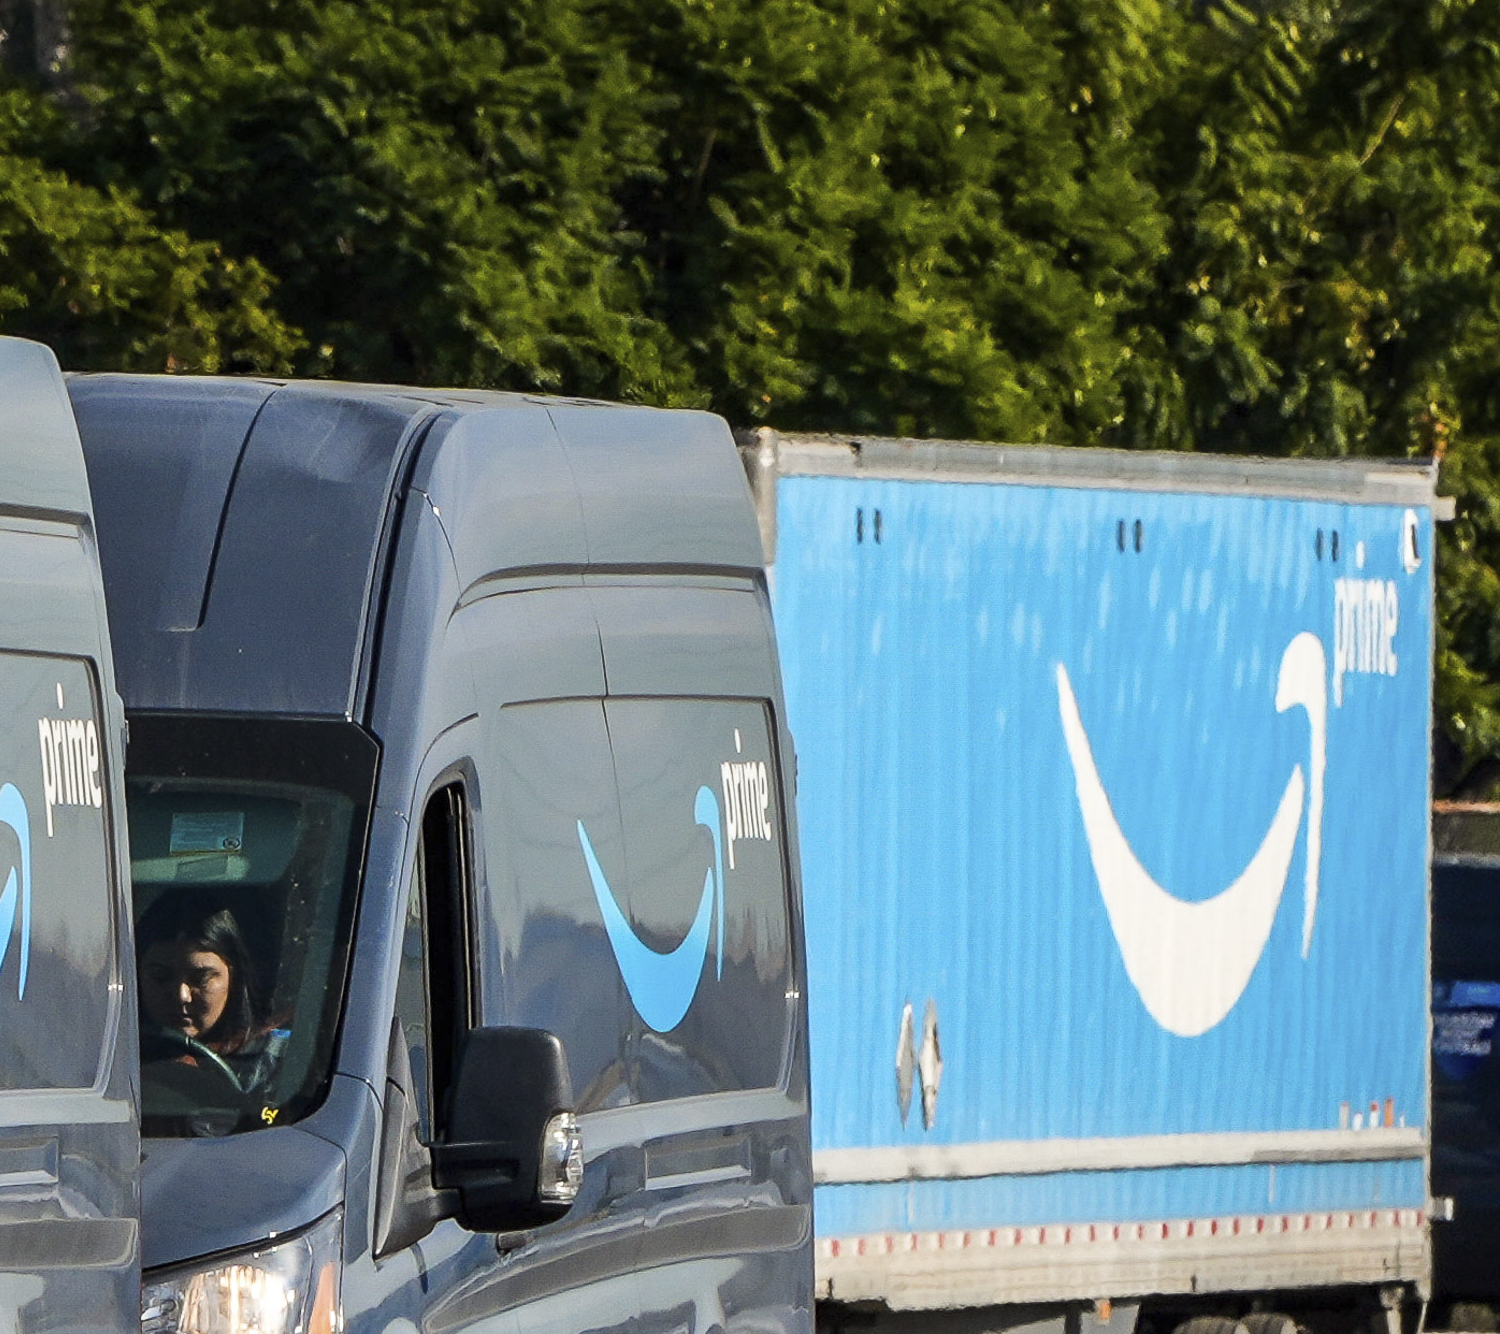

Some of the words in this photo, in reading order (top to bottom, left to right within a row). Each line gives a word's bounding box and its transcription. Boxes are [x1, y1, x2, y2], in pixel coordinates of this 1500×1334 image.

[1332, 540, 1399, 708] prime
[37, 681, 104, 839] prime
[719, 727, 773, 871] prime
